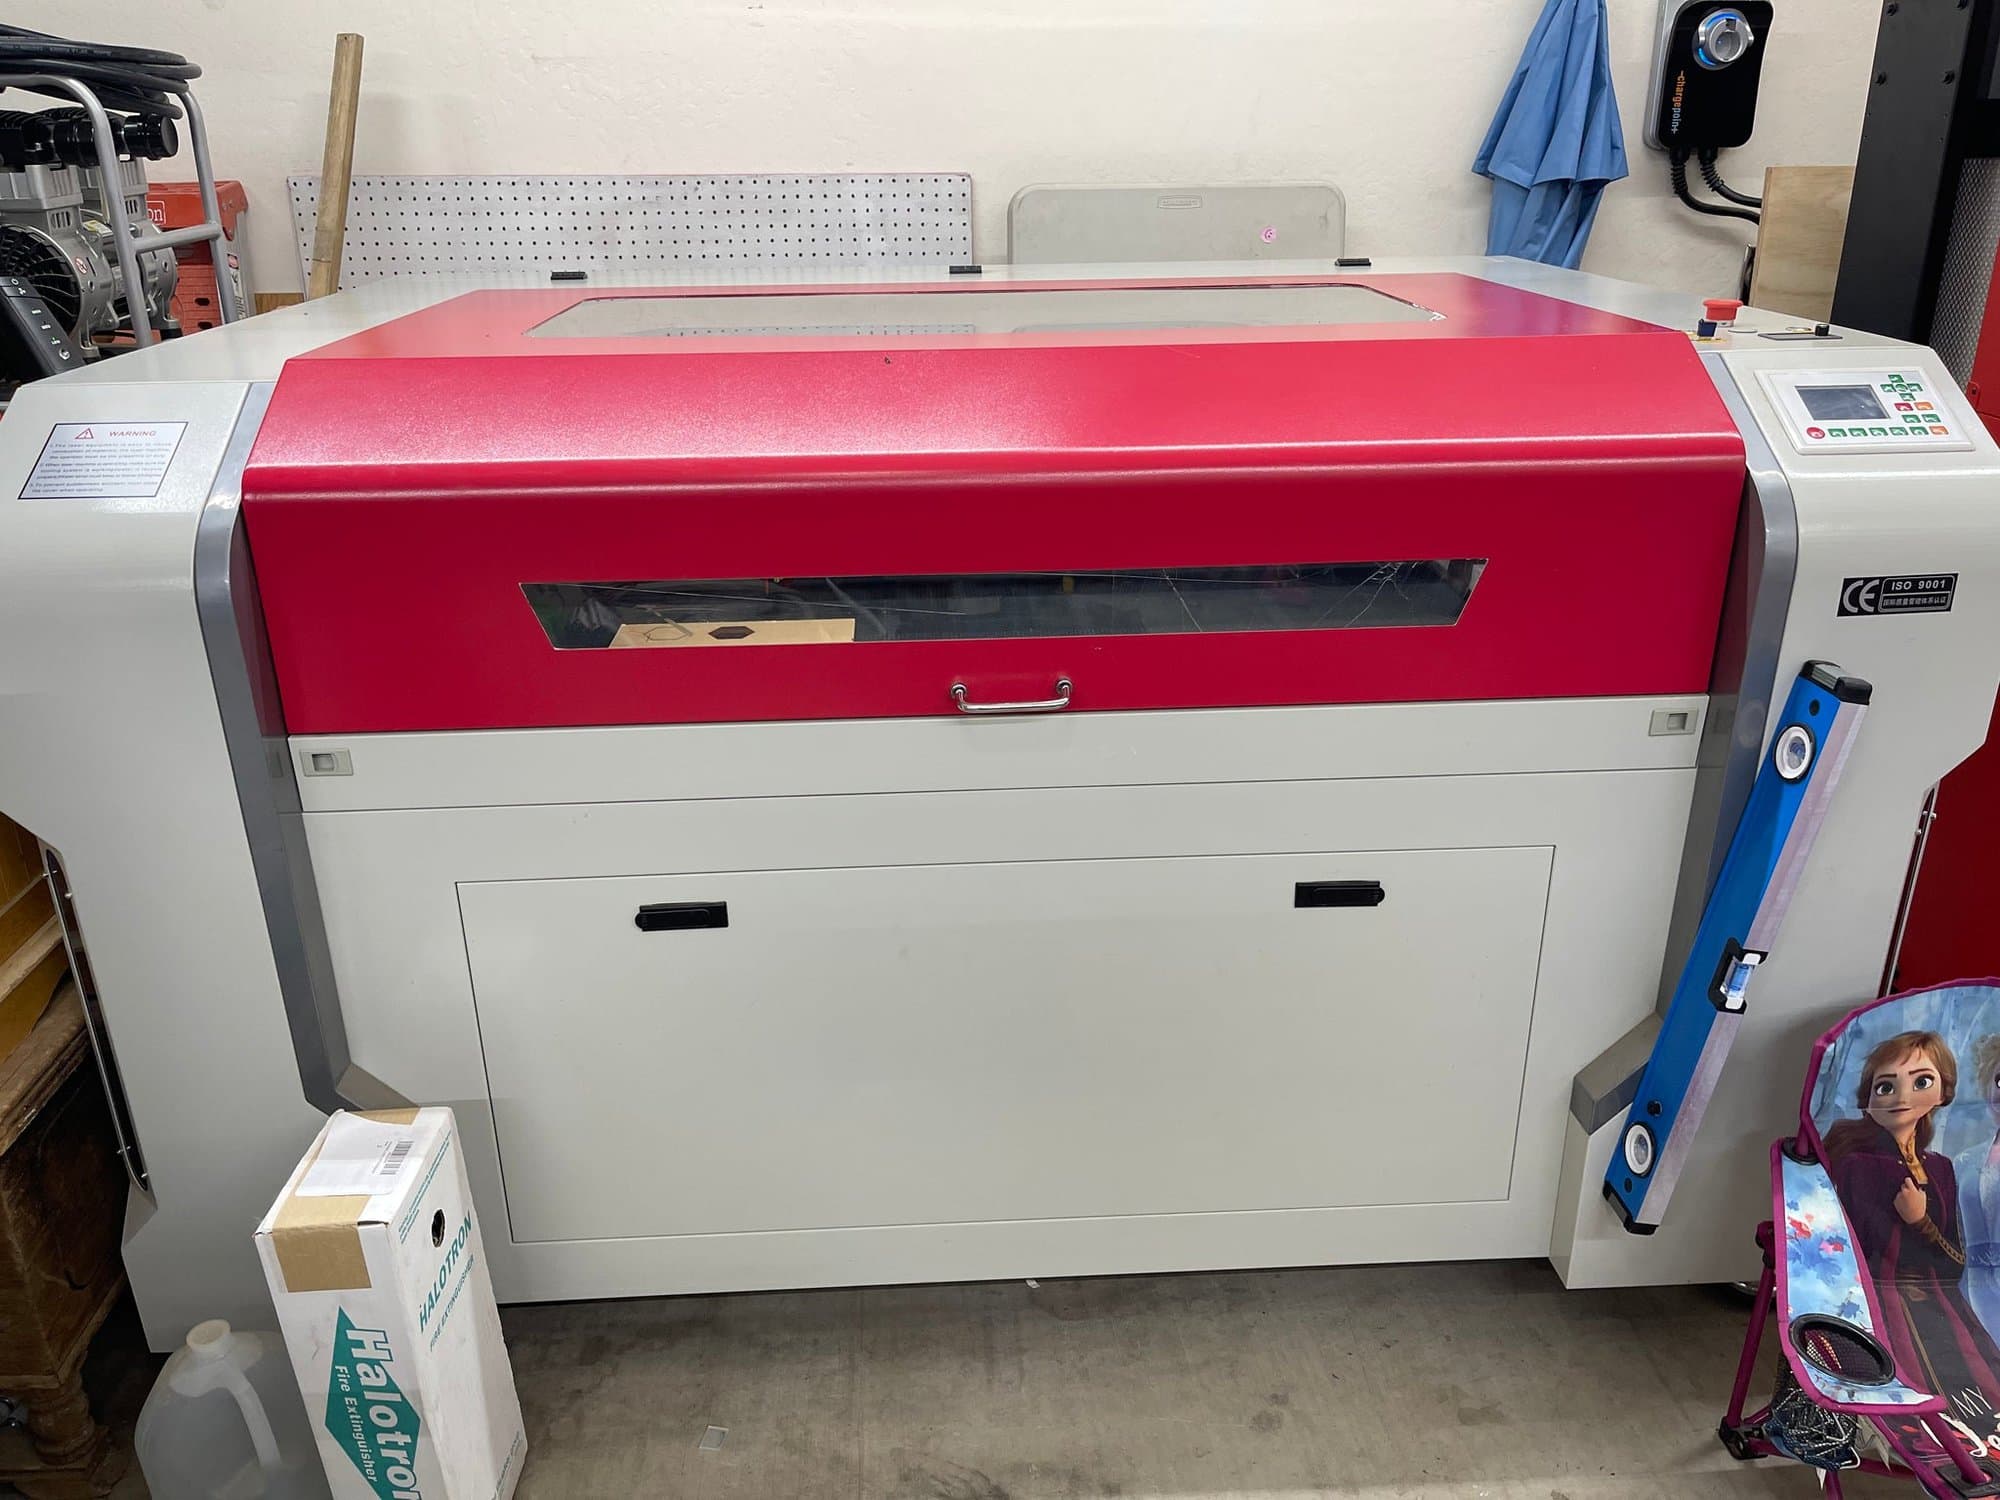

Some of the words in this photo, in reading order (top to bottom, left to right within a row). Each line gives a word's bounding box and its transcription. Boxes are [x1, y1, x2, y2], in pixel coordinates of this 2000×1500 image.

[1891, 581, 1912, 591] ISO
[1918, 579, 1946, 590] 9001
[419, 1210, 472, 1334] HALOTRON
[335, 1365, 350, 1392] Fire
[344, 1397, 378, 1483] Extinguisher
[1951, 1385, 1992, 1419] MY
